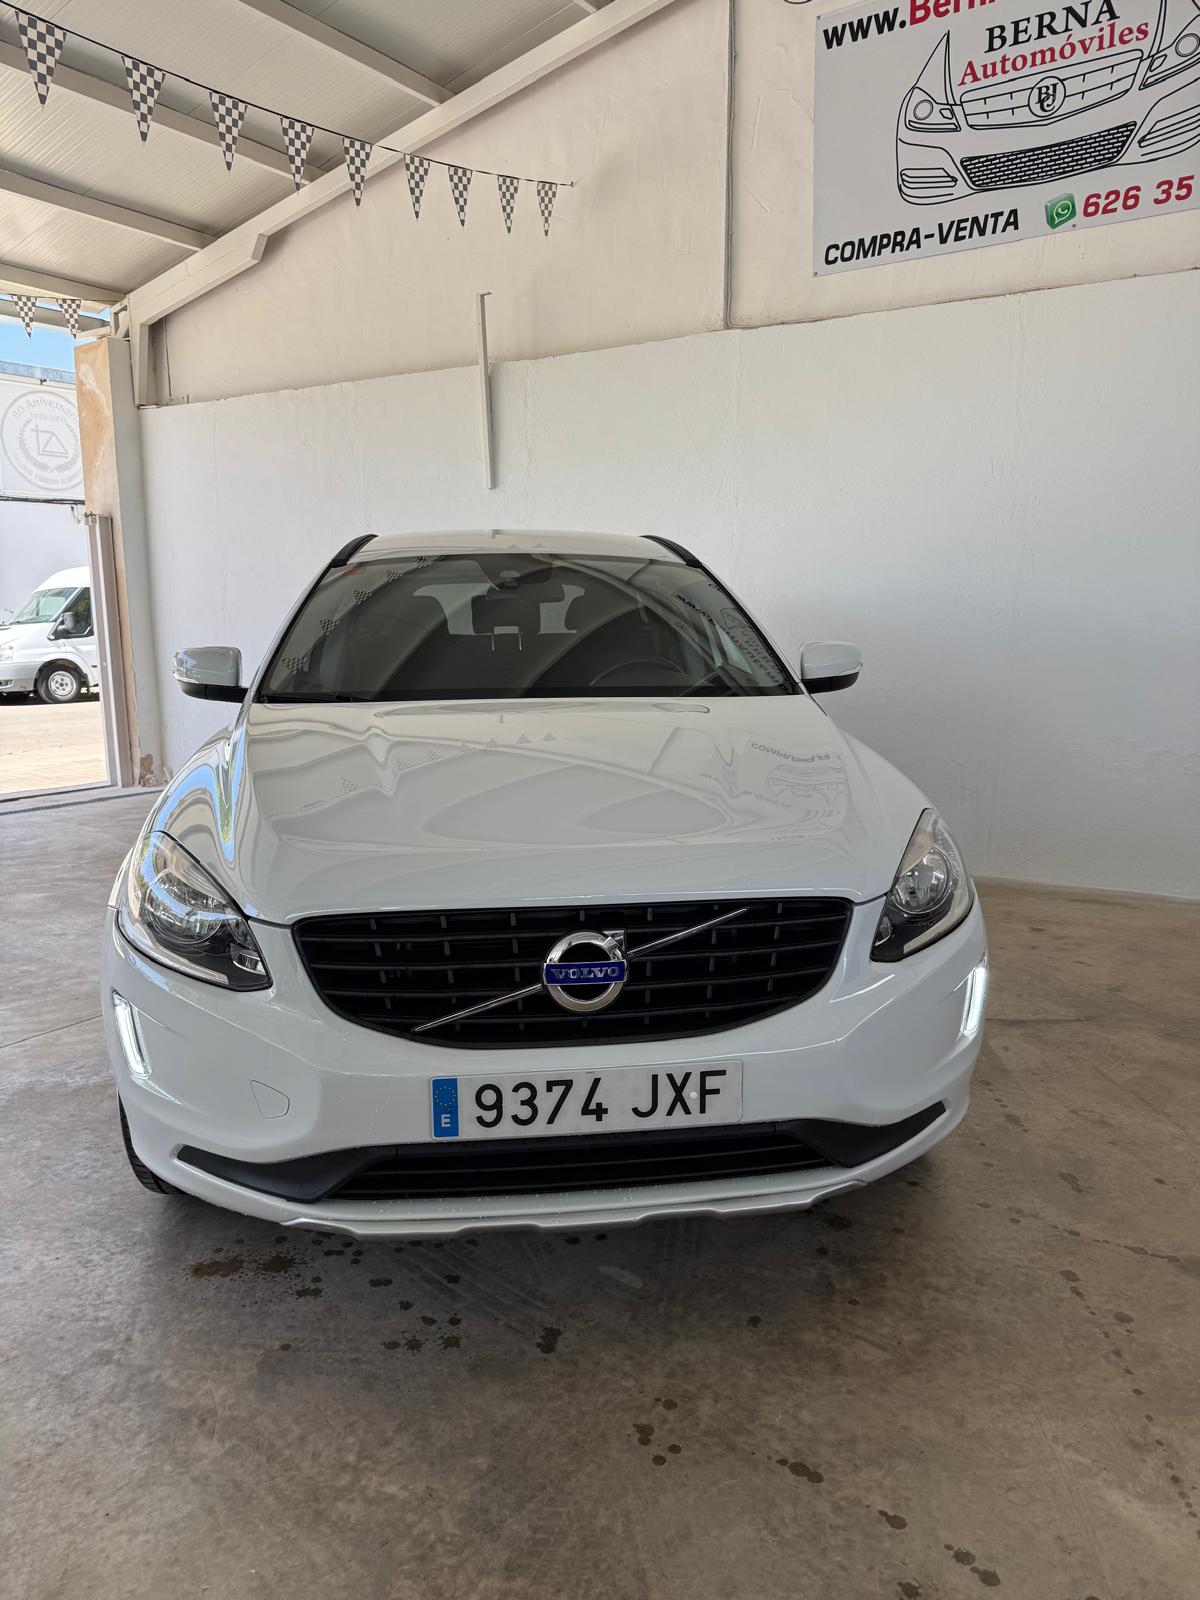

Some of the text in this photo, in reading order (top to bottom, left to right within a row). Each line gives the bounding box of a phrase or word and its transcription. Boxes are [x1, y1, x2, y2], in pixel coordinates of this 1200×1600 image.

[984, 0, 1120, 53] BERNA
[957, 22, 1150, 87] Automóviles
[1083, 174, 1195, 218] 626 35
[824, 208, 1020, 265] COMPRA-VENTA
[551, 966, 620, 980] VOLVO
[441, 1113, 452, 1128] E
[474, 1069, 727, 1129] 9374 JXF
